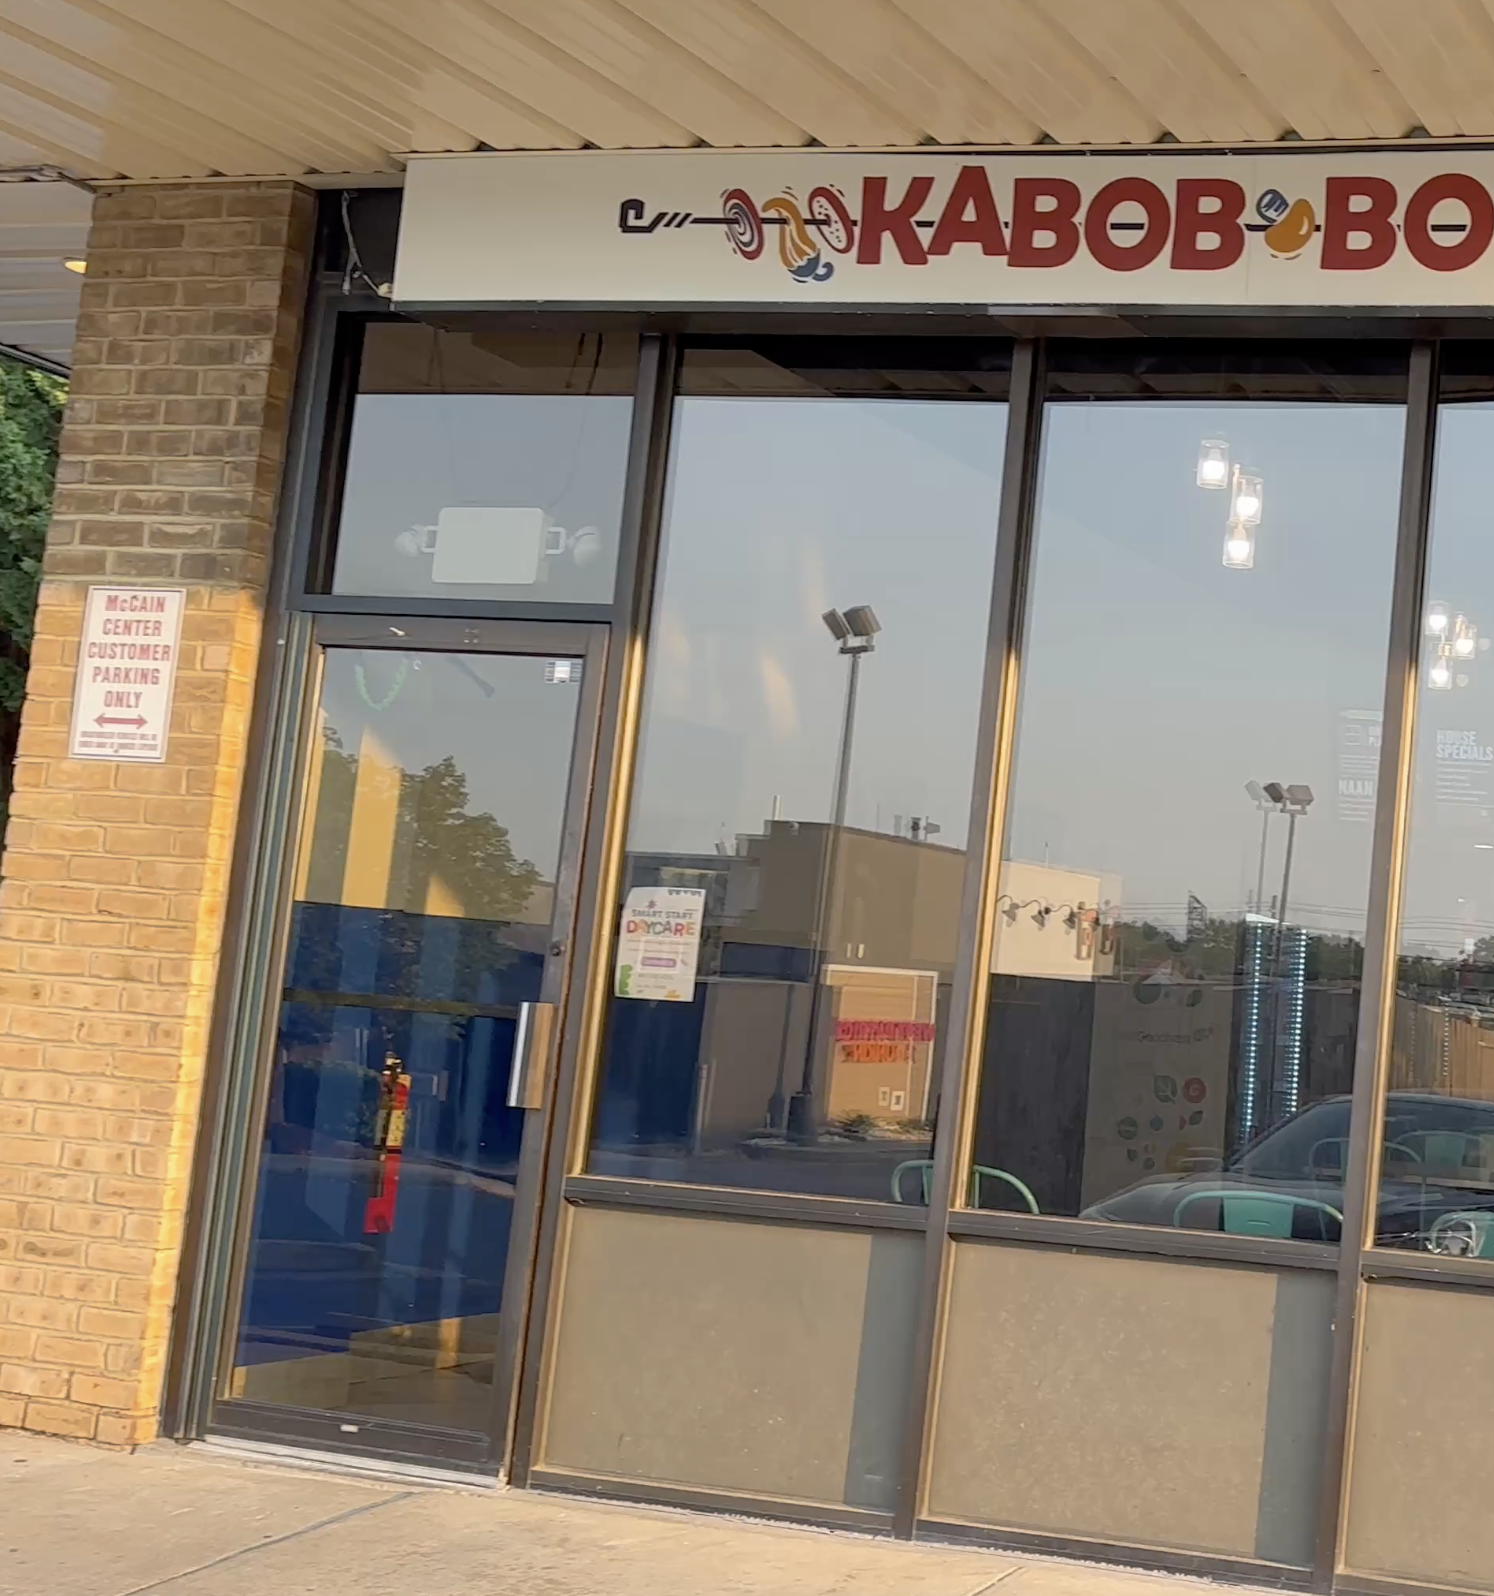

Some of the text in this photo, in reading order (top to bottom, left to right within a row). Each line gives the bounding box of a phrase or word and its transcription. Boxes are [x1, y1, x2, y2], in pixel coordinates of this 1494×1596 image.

[856, 166, 1245, 272] KABOB
[105, 595, 166, 613] McCAIN
[102, 618, 163, 637] CENTER
[88, 642, 171, 662] CUSTOMER
[92, 666, 161, 685] PARKING
[104, 690, 143, 709] ONLY
[1436, 729, 1477, 746] HOUSE
[1436, 745, 1494, 761] SPECIALS
[627, 919, 696, 936] DAYCARE
